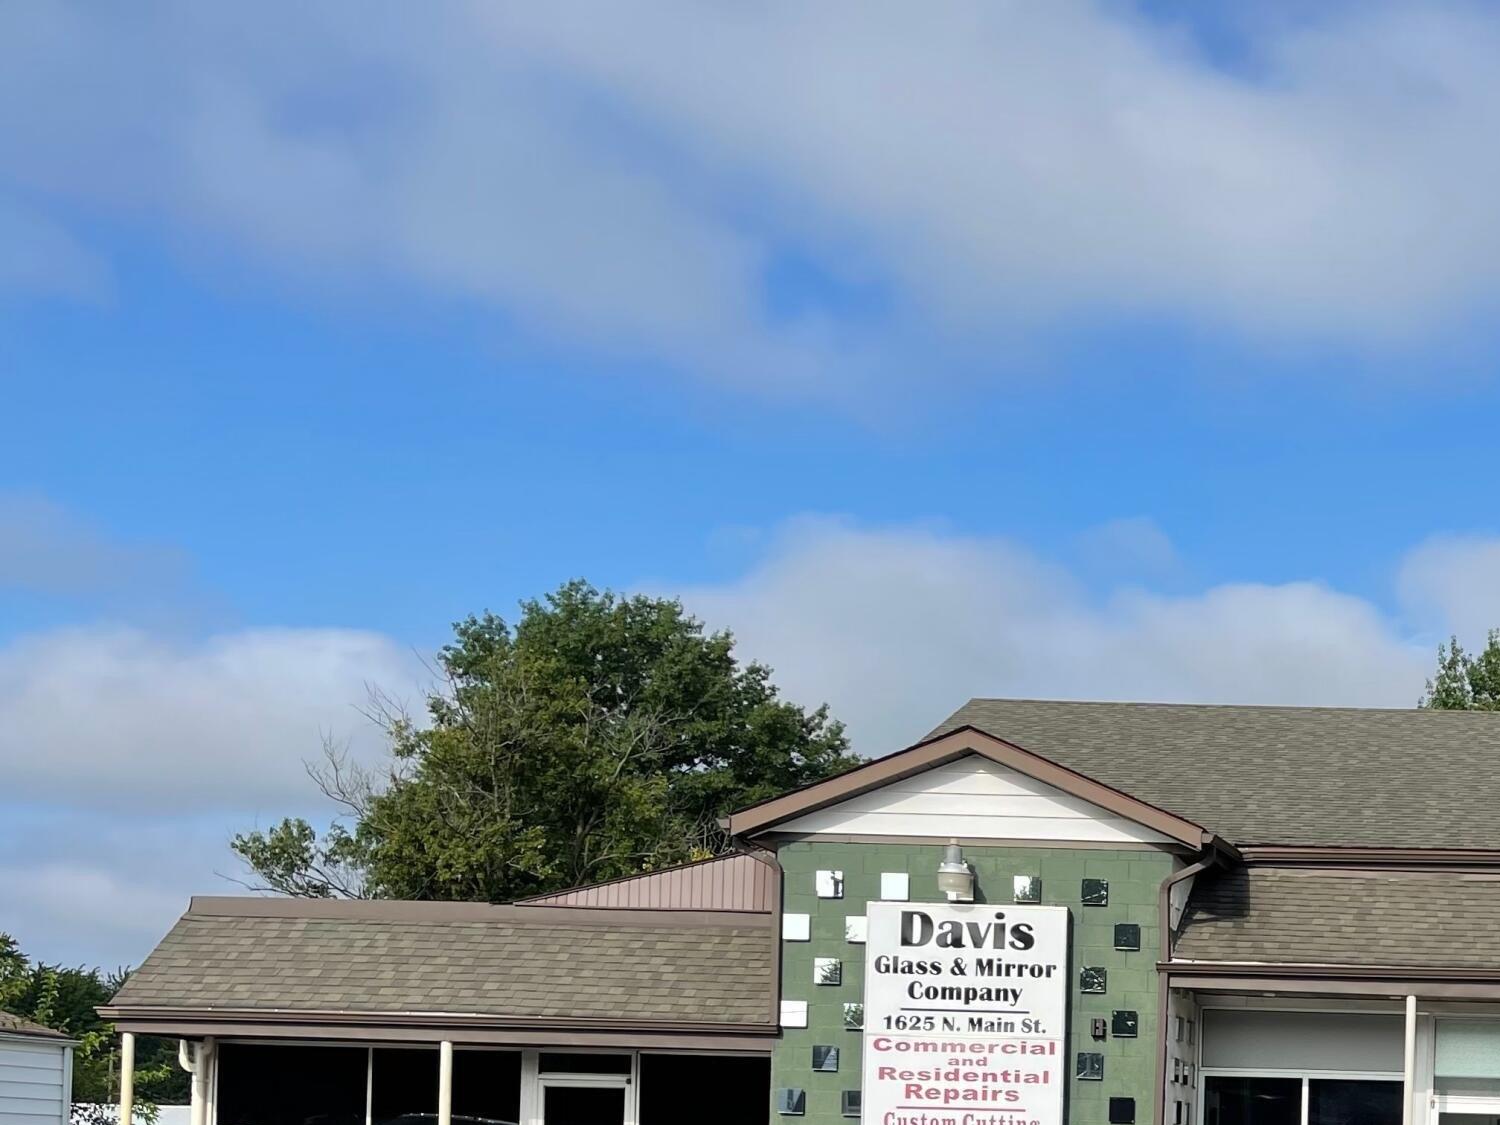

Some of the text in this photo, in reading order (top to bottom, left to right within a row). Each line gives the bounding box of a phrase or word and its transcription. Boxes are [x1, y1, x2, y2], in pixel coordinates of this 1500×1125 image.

[900, 911, 1035, 951] Davis
[874, 956, 1057, 978] Glass & Mirror
[907, 981, 1023, 1006] Company
[883, 1016, 1046, 1034] 1625 N. Main St.
[873, 1038, 1056, 1055] Commercial
[948, 1057, 988, 1066] and
[878, 1067, 1049, 1084] Residential
[904, 1084, 1020, 1104] Repairs
